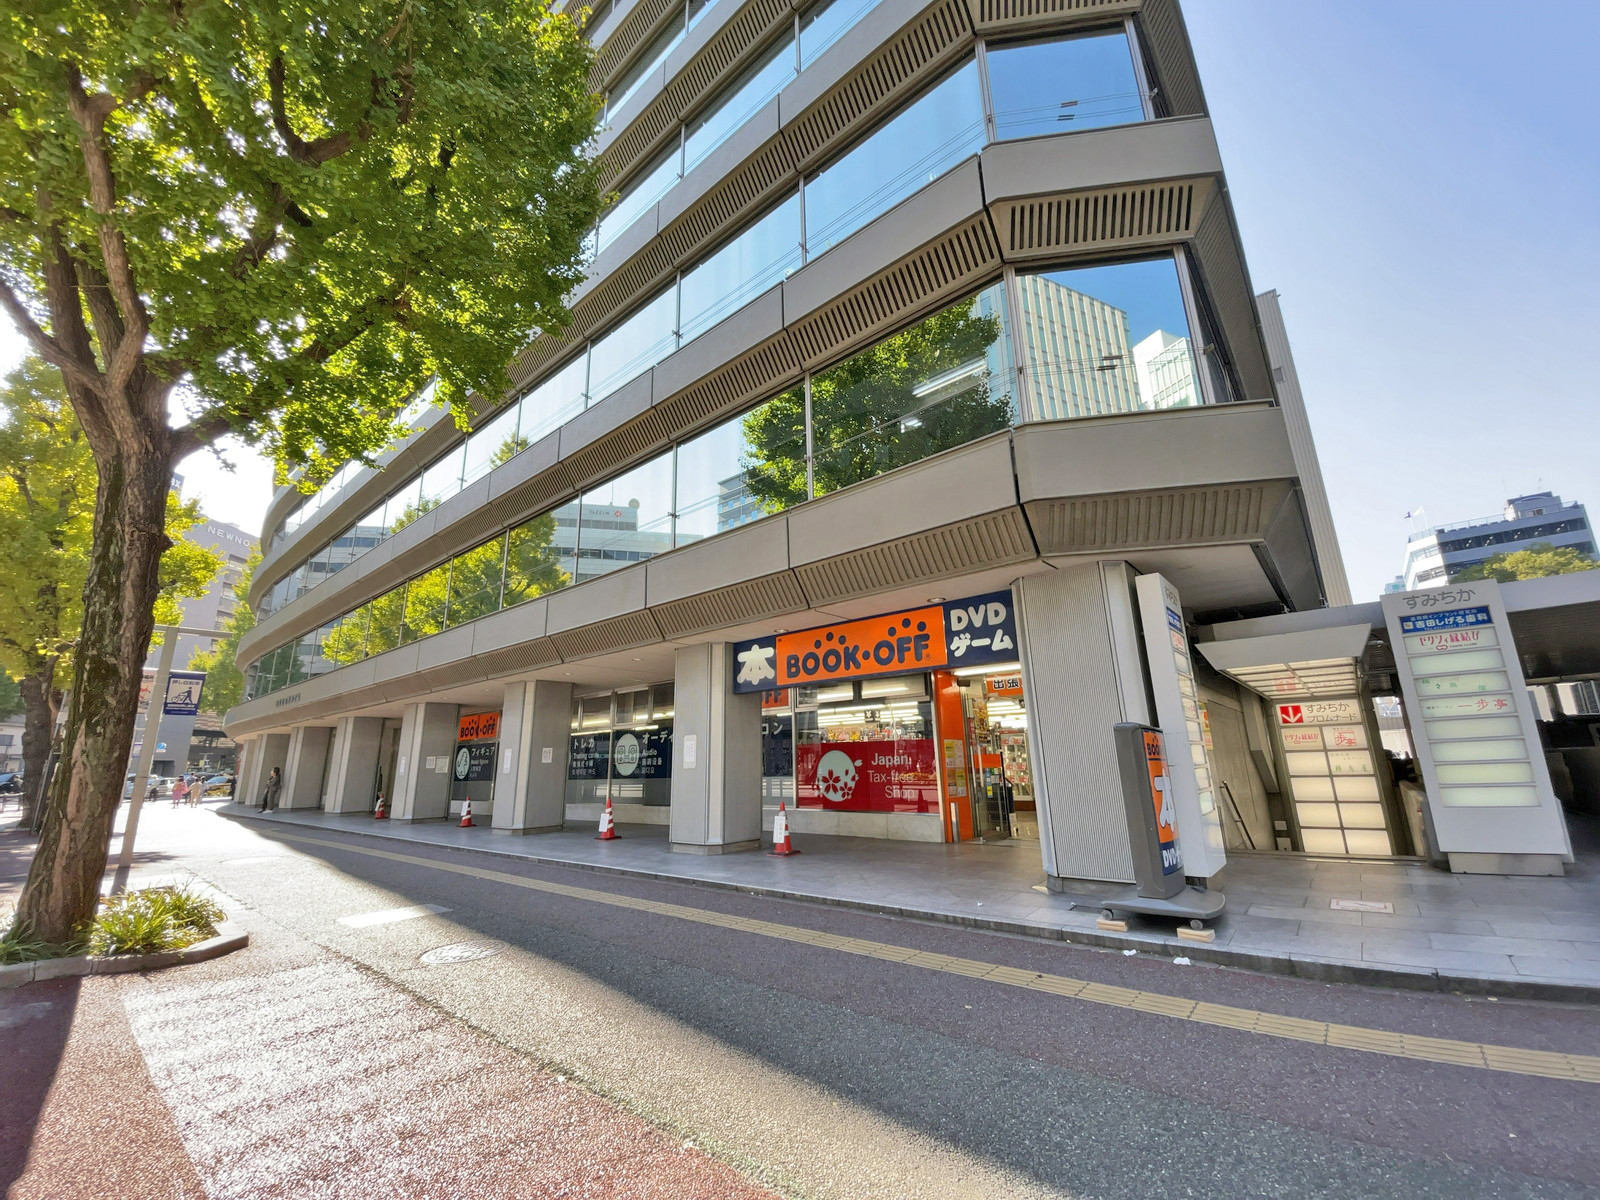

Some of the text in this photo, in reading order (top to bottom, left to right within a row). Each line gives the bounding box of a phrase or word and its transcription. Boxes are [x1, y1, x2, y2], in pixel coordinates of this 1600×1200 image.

[1403, 588, 1476, 610] すみちか
[950, 602, 1007, 632] DVD
[950, 629, 1014, 657] ゲーム
[737, 644, 775, 686] 本
[993, 677, 1024, 690] 出張
[1305, 702, 1350, 713] すみちか
[1306, 713, 1357, 723] プロムナード
[573, 738, 595, 750] トレカ
[1147, 742, 1163, 756] BOO
[471, 746, 495, 757] フィギュア
[871, 752, 908, 769] Japan
[867, 770, 914, 783] Tax-free
[885, 785, 915, 802] Shop
